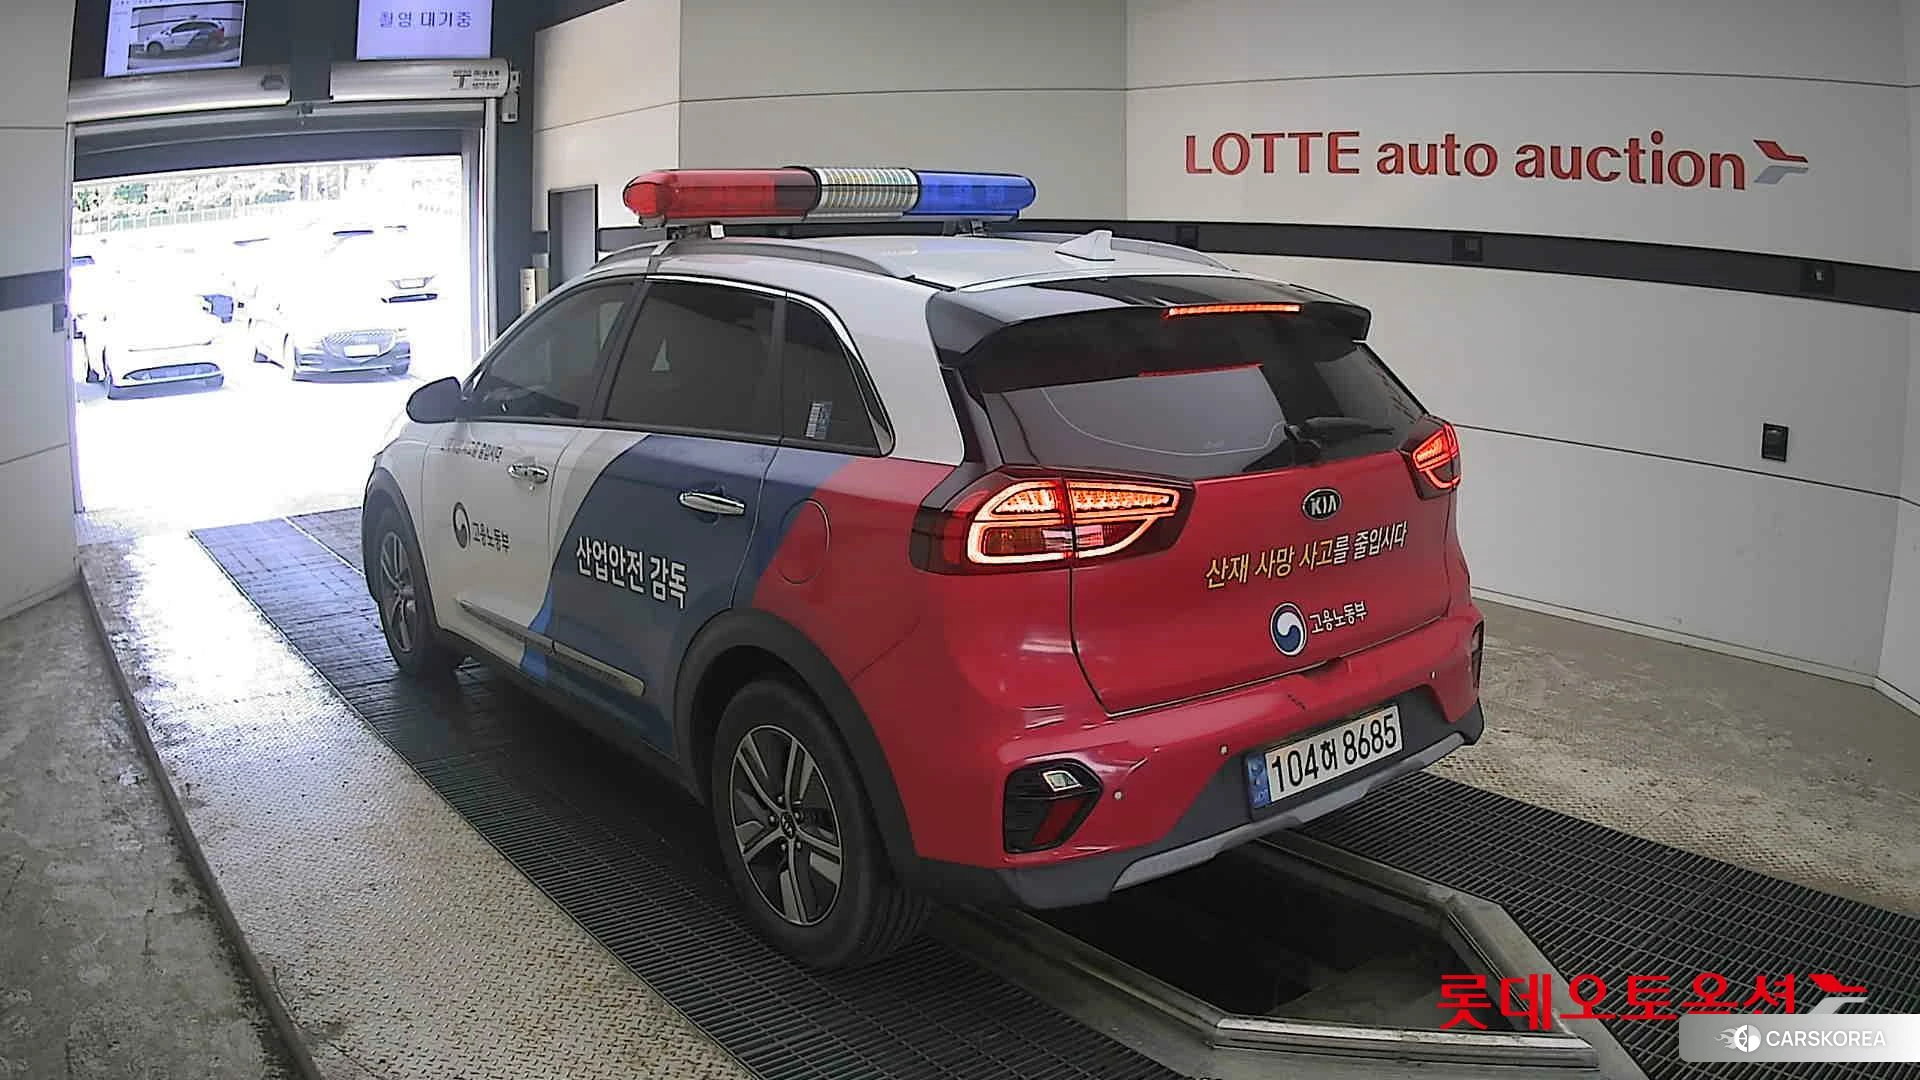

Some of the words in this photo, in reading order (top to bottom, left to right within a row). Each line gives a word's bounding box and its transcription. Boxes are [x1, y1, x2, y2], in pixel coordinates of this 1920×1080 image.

[420, 11, 472, 28] 대기중
[1185, 131, 1361, 174] LOTTE
[1376, 133, 1498, 178] auto
[1514, 130, 1747, 190] auction
[1310, 496, 1337, 516] KIA
[472, 522, 511, 555] 고용노동부
[1206, 553, 1249, 589] 산재
[1254, 545, 1295, 579] 사망
[1298, 536, 1350, 571] 사고를
[1354, 521, 1407, 560] 줄입시다
[575, 536, 645, 594] 산업안전
[648, 555, 688, 610] 감독
[1309, 600, 1367, 635] 고용노동부
[1271, 739, 1338, 792] 104허
[1343, 714, 1397, 765] 8685
